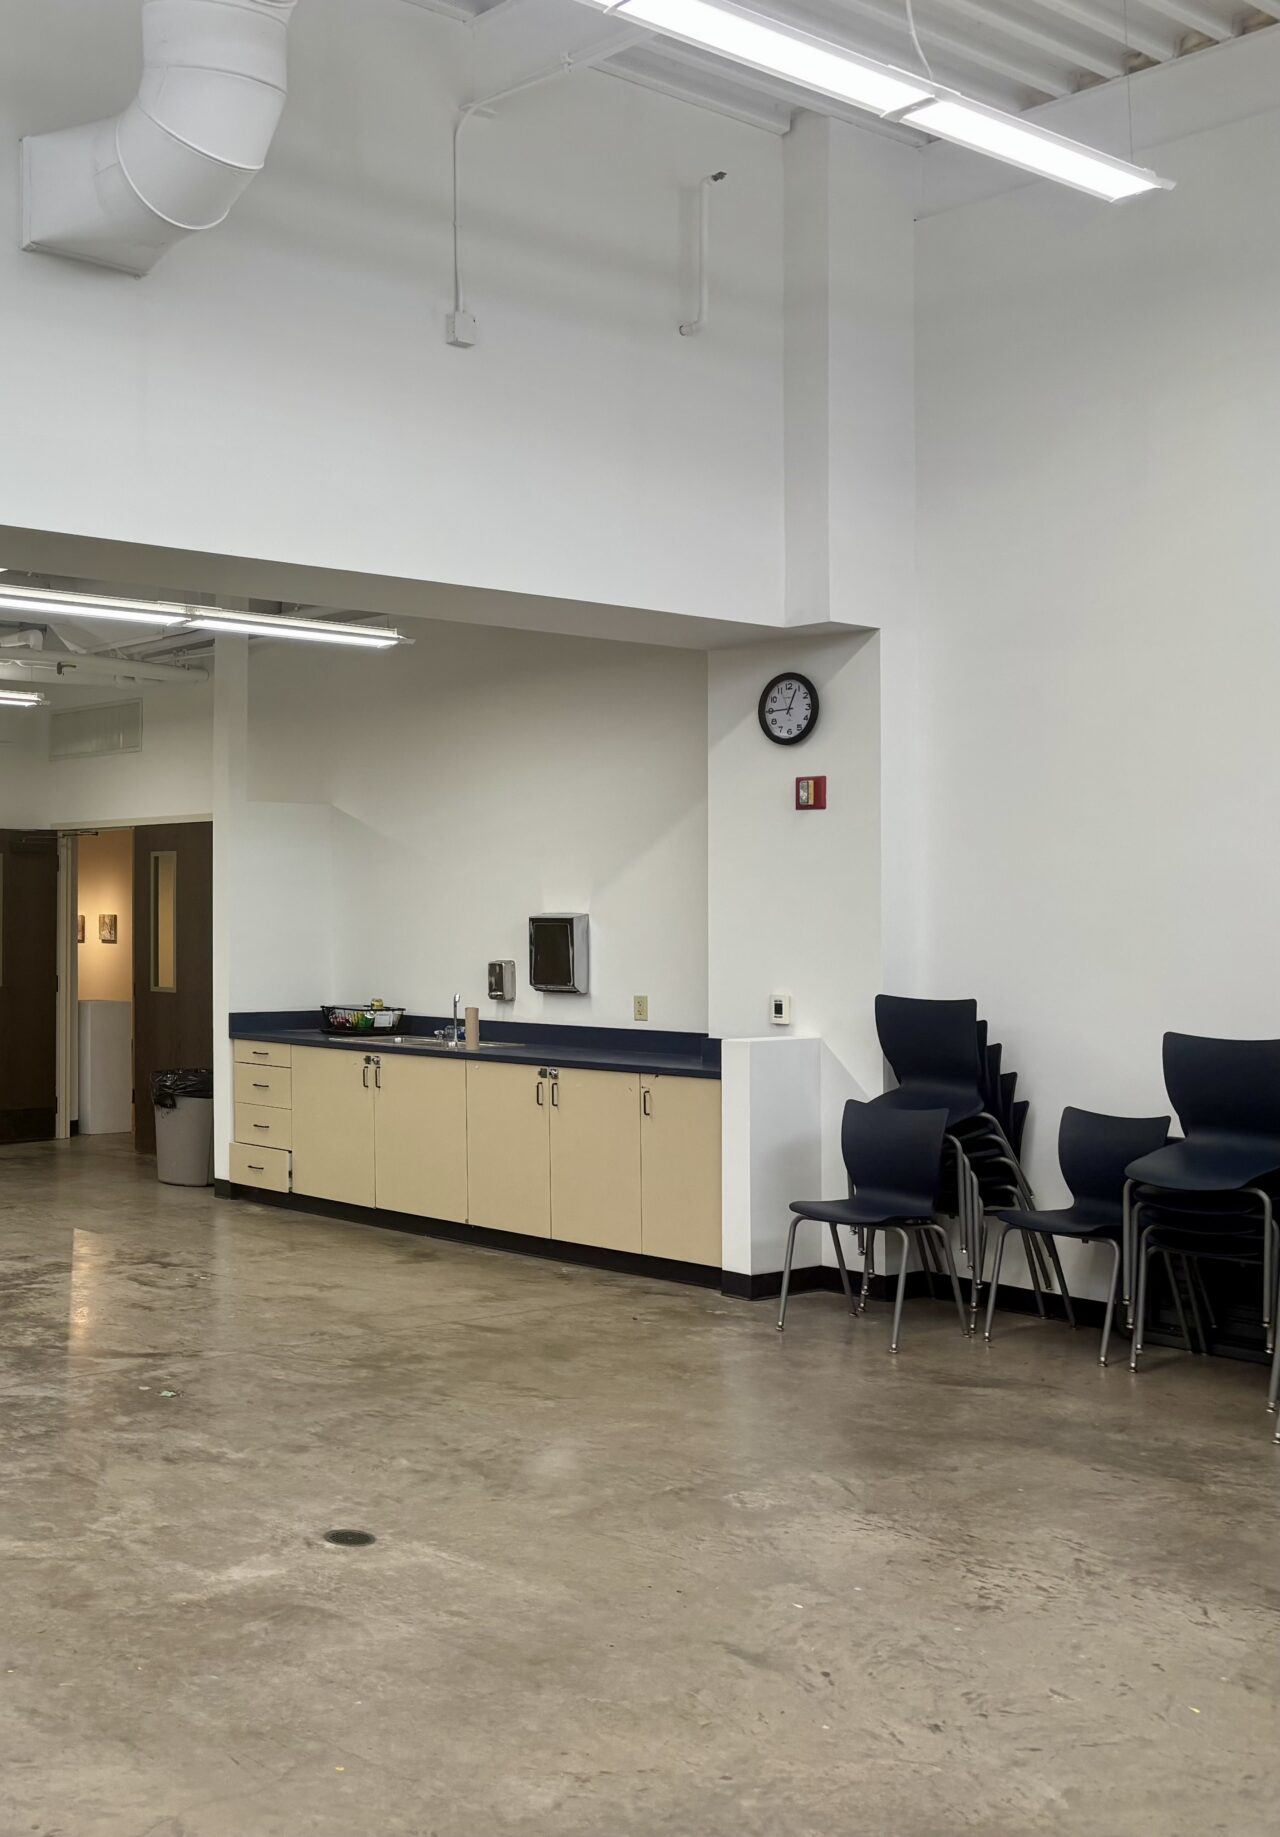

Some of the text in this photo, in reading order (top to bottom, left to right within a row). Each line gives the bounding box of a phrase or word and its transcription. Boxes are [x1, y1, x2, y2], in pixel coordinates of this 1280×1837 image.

[785, 682, 793, 690] 12
[770, 695, 777, 703] 10
[805, 703, 811, 711] 3
